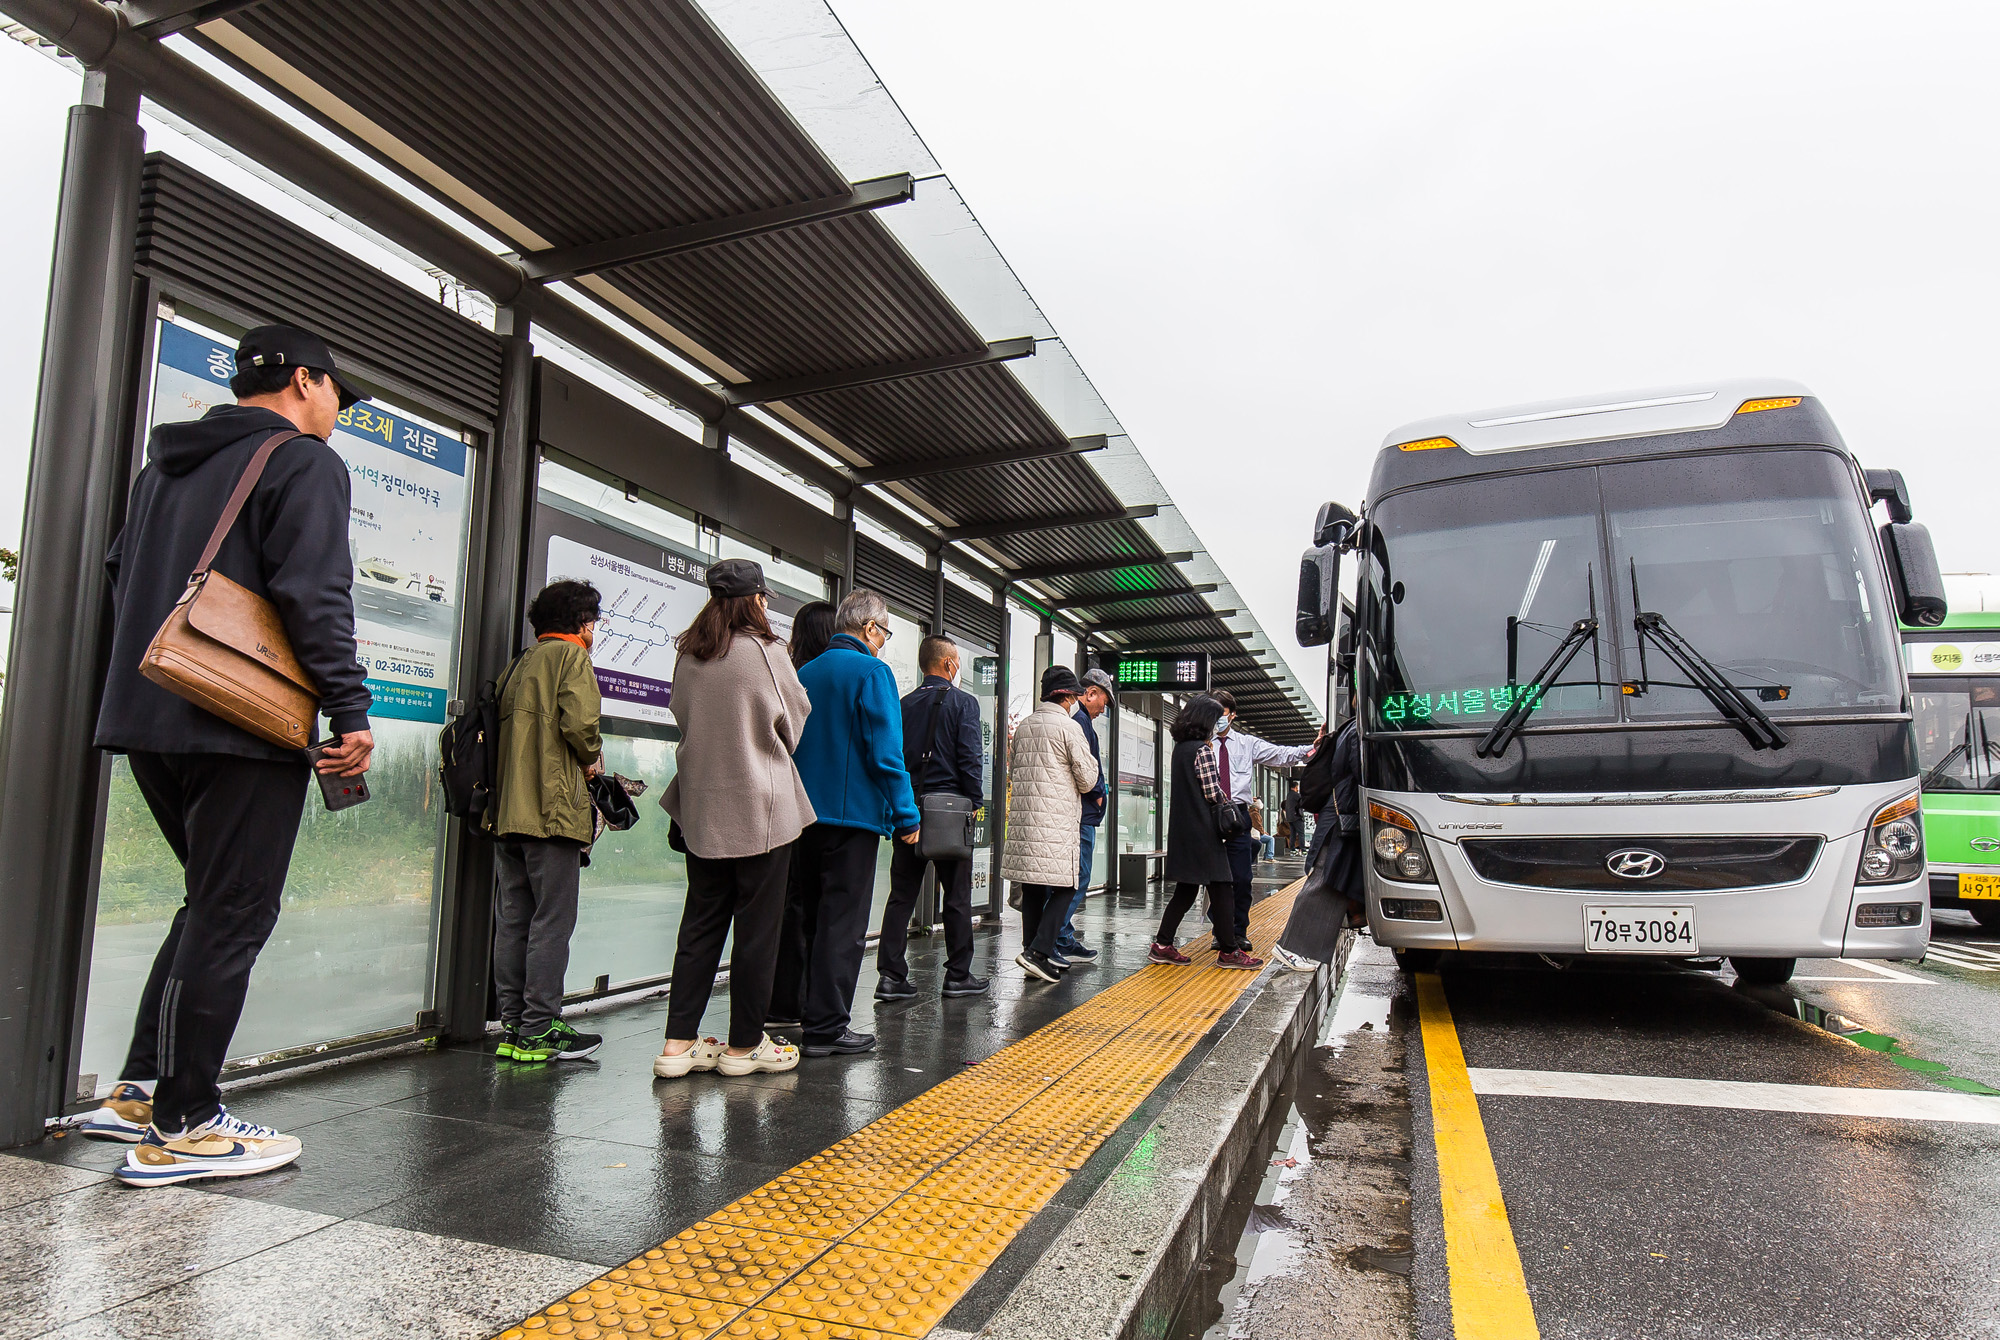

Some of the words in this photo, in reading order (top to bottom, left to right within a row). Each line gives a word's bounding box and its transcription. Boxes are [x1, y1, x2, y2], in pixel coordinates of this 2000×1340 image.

[402, 426, 439, 460] 전문
[590, 553, 631, 577] 삼성서울병원
[668, 555, 685, 575] 병원
[687, 563, 707, 582] 셔틀
[375, 659, 434, 679] 02-3412-7655
[1932, 653, 1962, 663] 장지동
[1438, 822, 1504, 830] UNIVERSE
[1590, 920, 1693, 944] 78무3084
